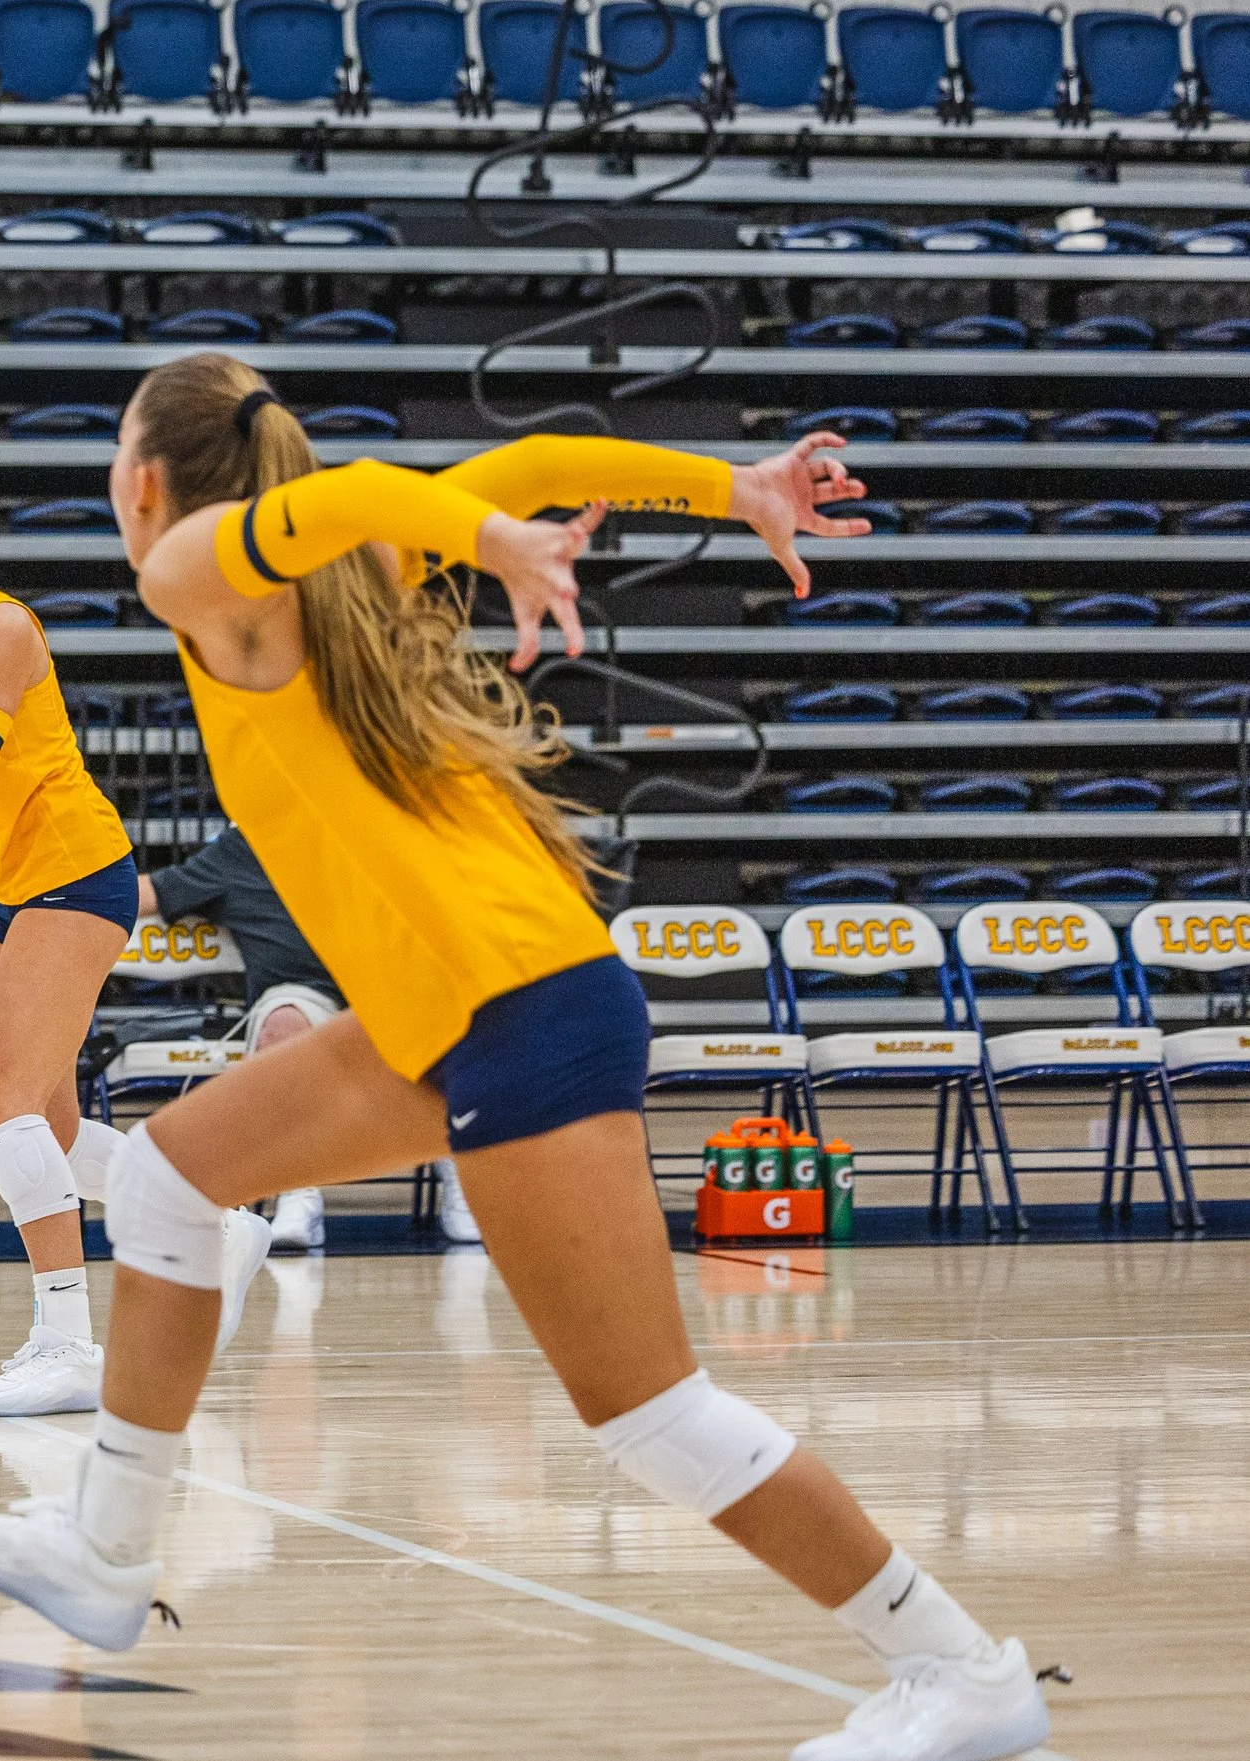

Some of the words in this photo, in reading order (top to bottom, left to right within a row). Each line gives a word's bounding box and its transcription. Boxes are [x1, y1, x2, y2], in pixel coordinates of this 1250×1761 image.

[118, 922, 221, 963] CCC
[632, 918, 741, 959] LCCC
[807, 917, 916, 957] LCCC
[982, 914, 1088, 954] LCCC
[1155, 914, 1250, 954] LCCC
[724, 1161, 745, 1184] G
[755, 1160, 776, 1183] G
[794, 1160, 815, 1183] G
[762, 1197, 791, 1230] G
